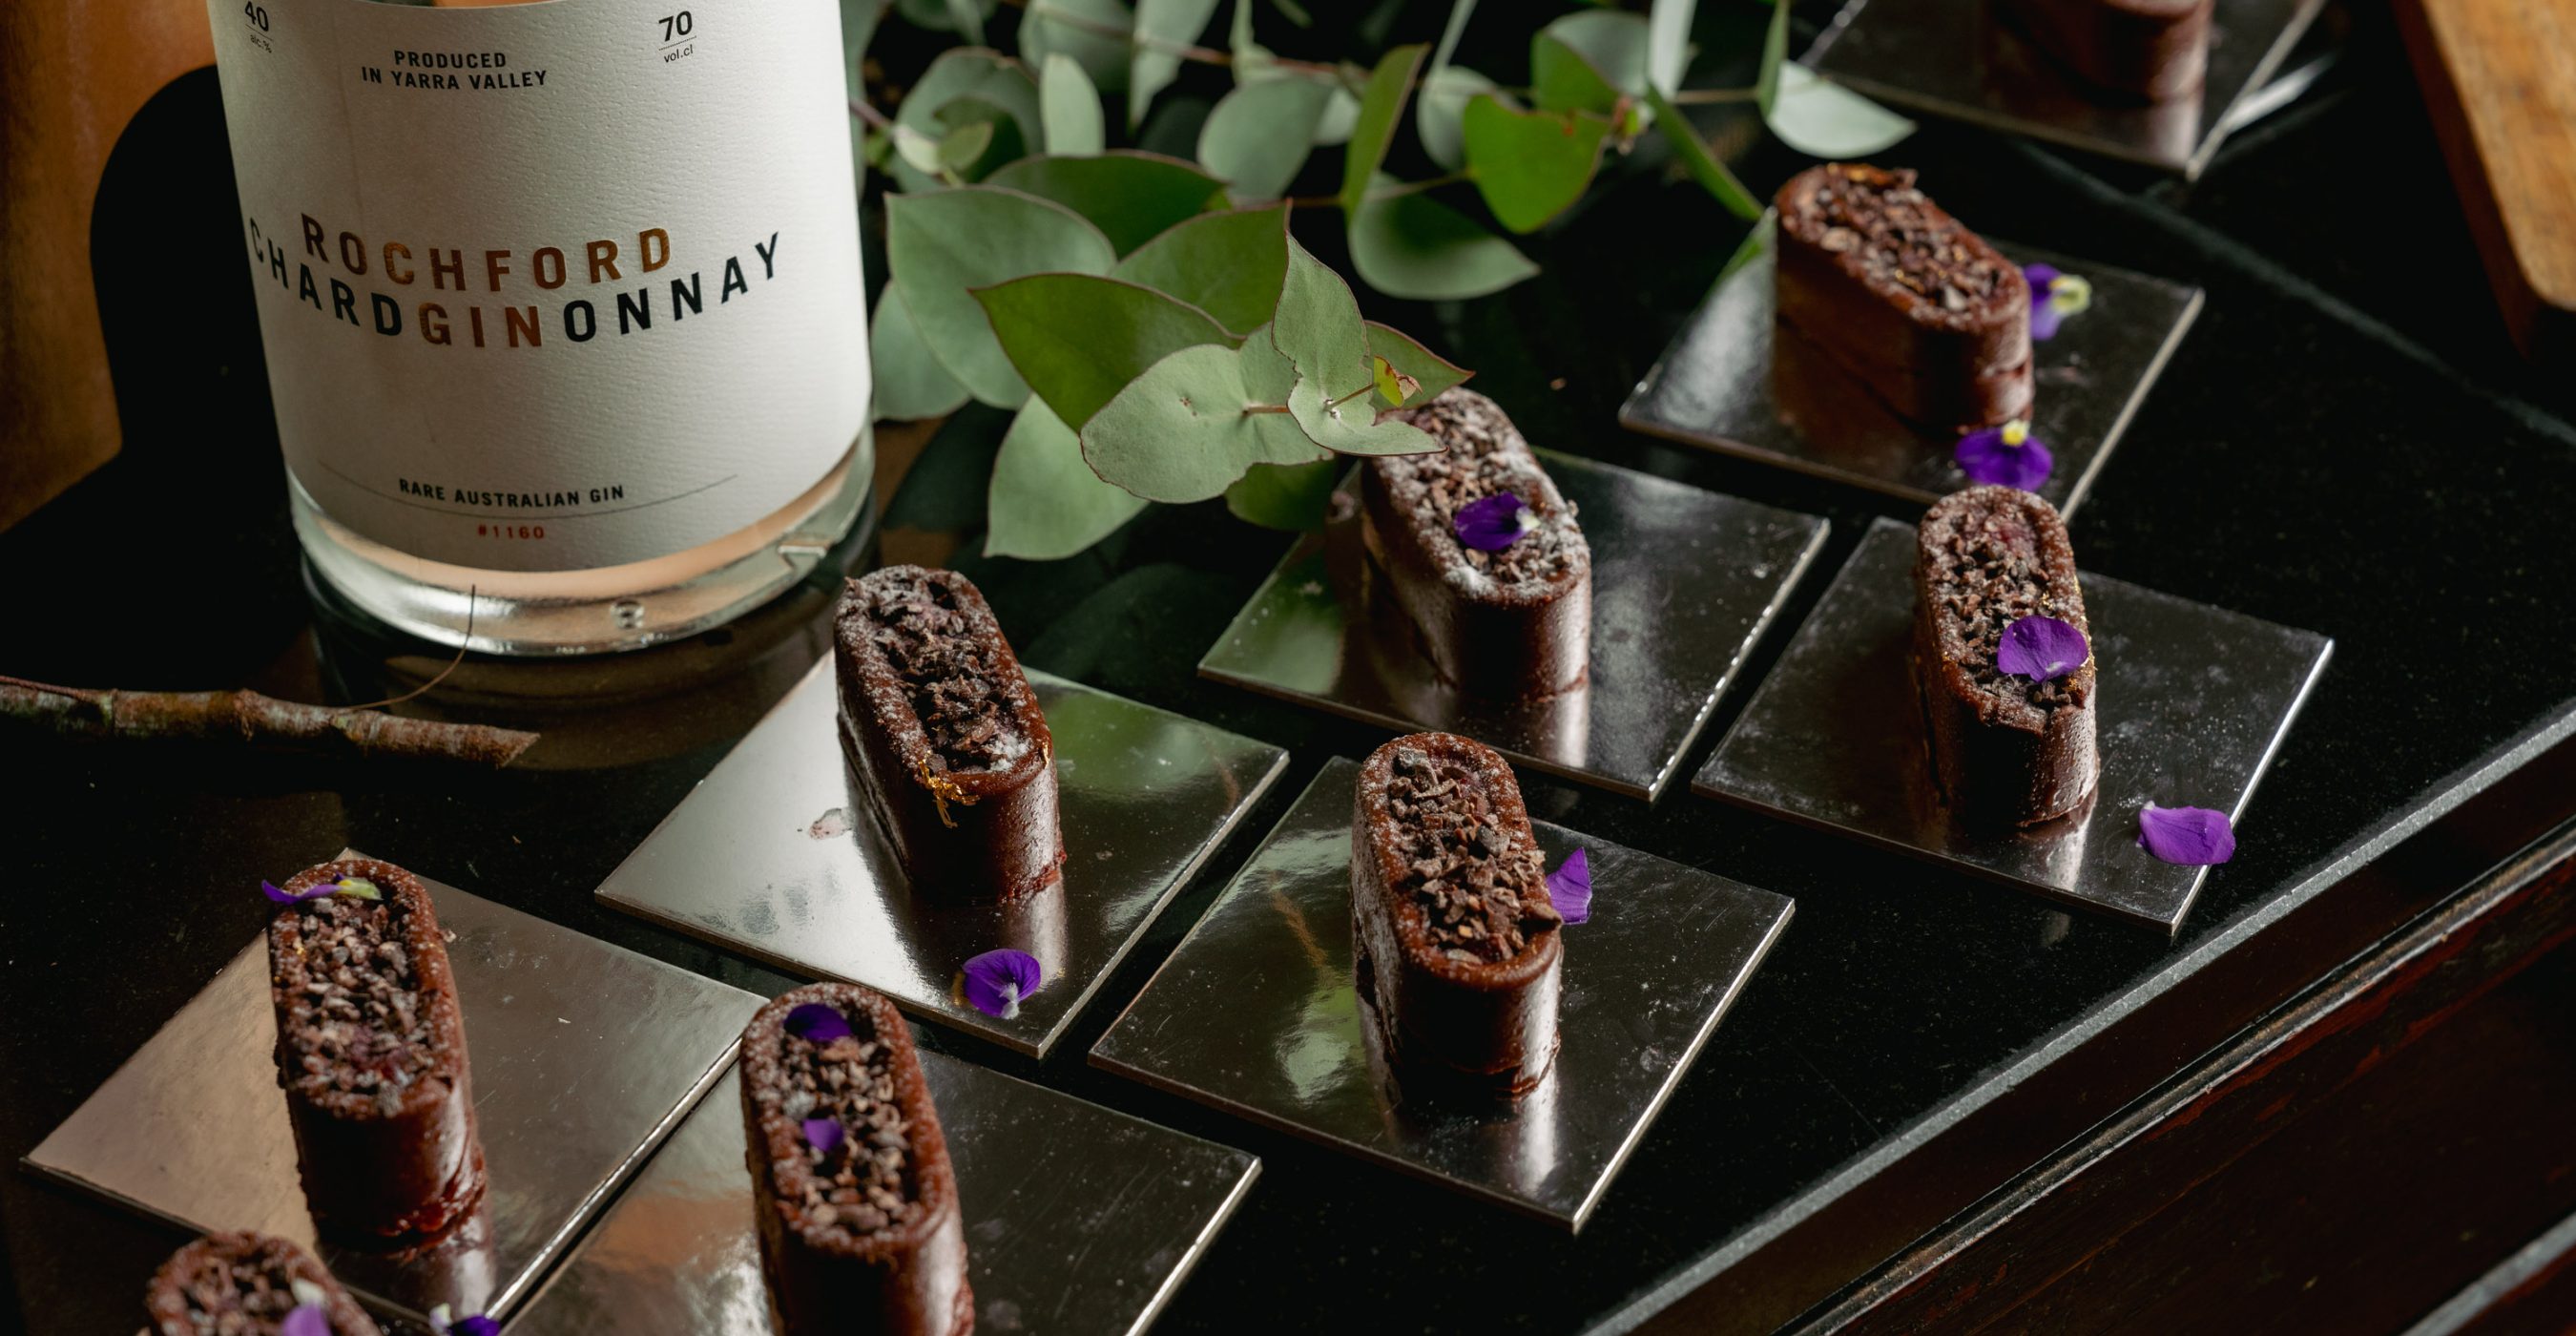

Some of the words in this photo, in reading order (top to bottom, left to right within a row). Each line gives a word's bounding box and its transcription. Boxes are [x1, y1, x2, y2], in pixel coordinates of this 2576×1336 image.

[244, 1, 269, 31] 40
[658, 10, 693, 42] 70
[394, 50, 507, 69] PRODUCED
[664, 44, 694, 63] vol.cl
[362, 67, 382, 84] IN
[391, 71, 460, 90] YARRA
[468, 70, 548, 90] VALLEY
[301, 213, 672, 292] ROCHFORD
[250, 218, 779, 347] CHARDGINONNAY
[399, 478, 446, 501] RARE
[455, 489, 580, 508] AUSTRALIAN
[590, 485, 624, 503] GIN
[478, 526, 545, 539] #1160
